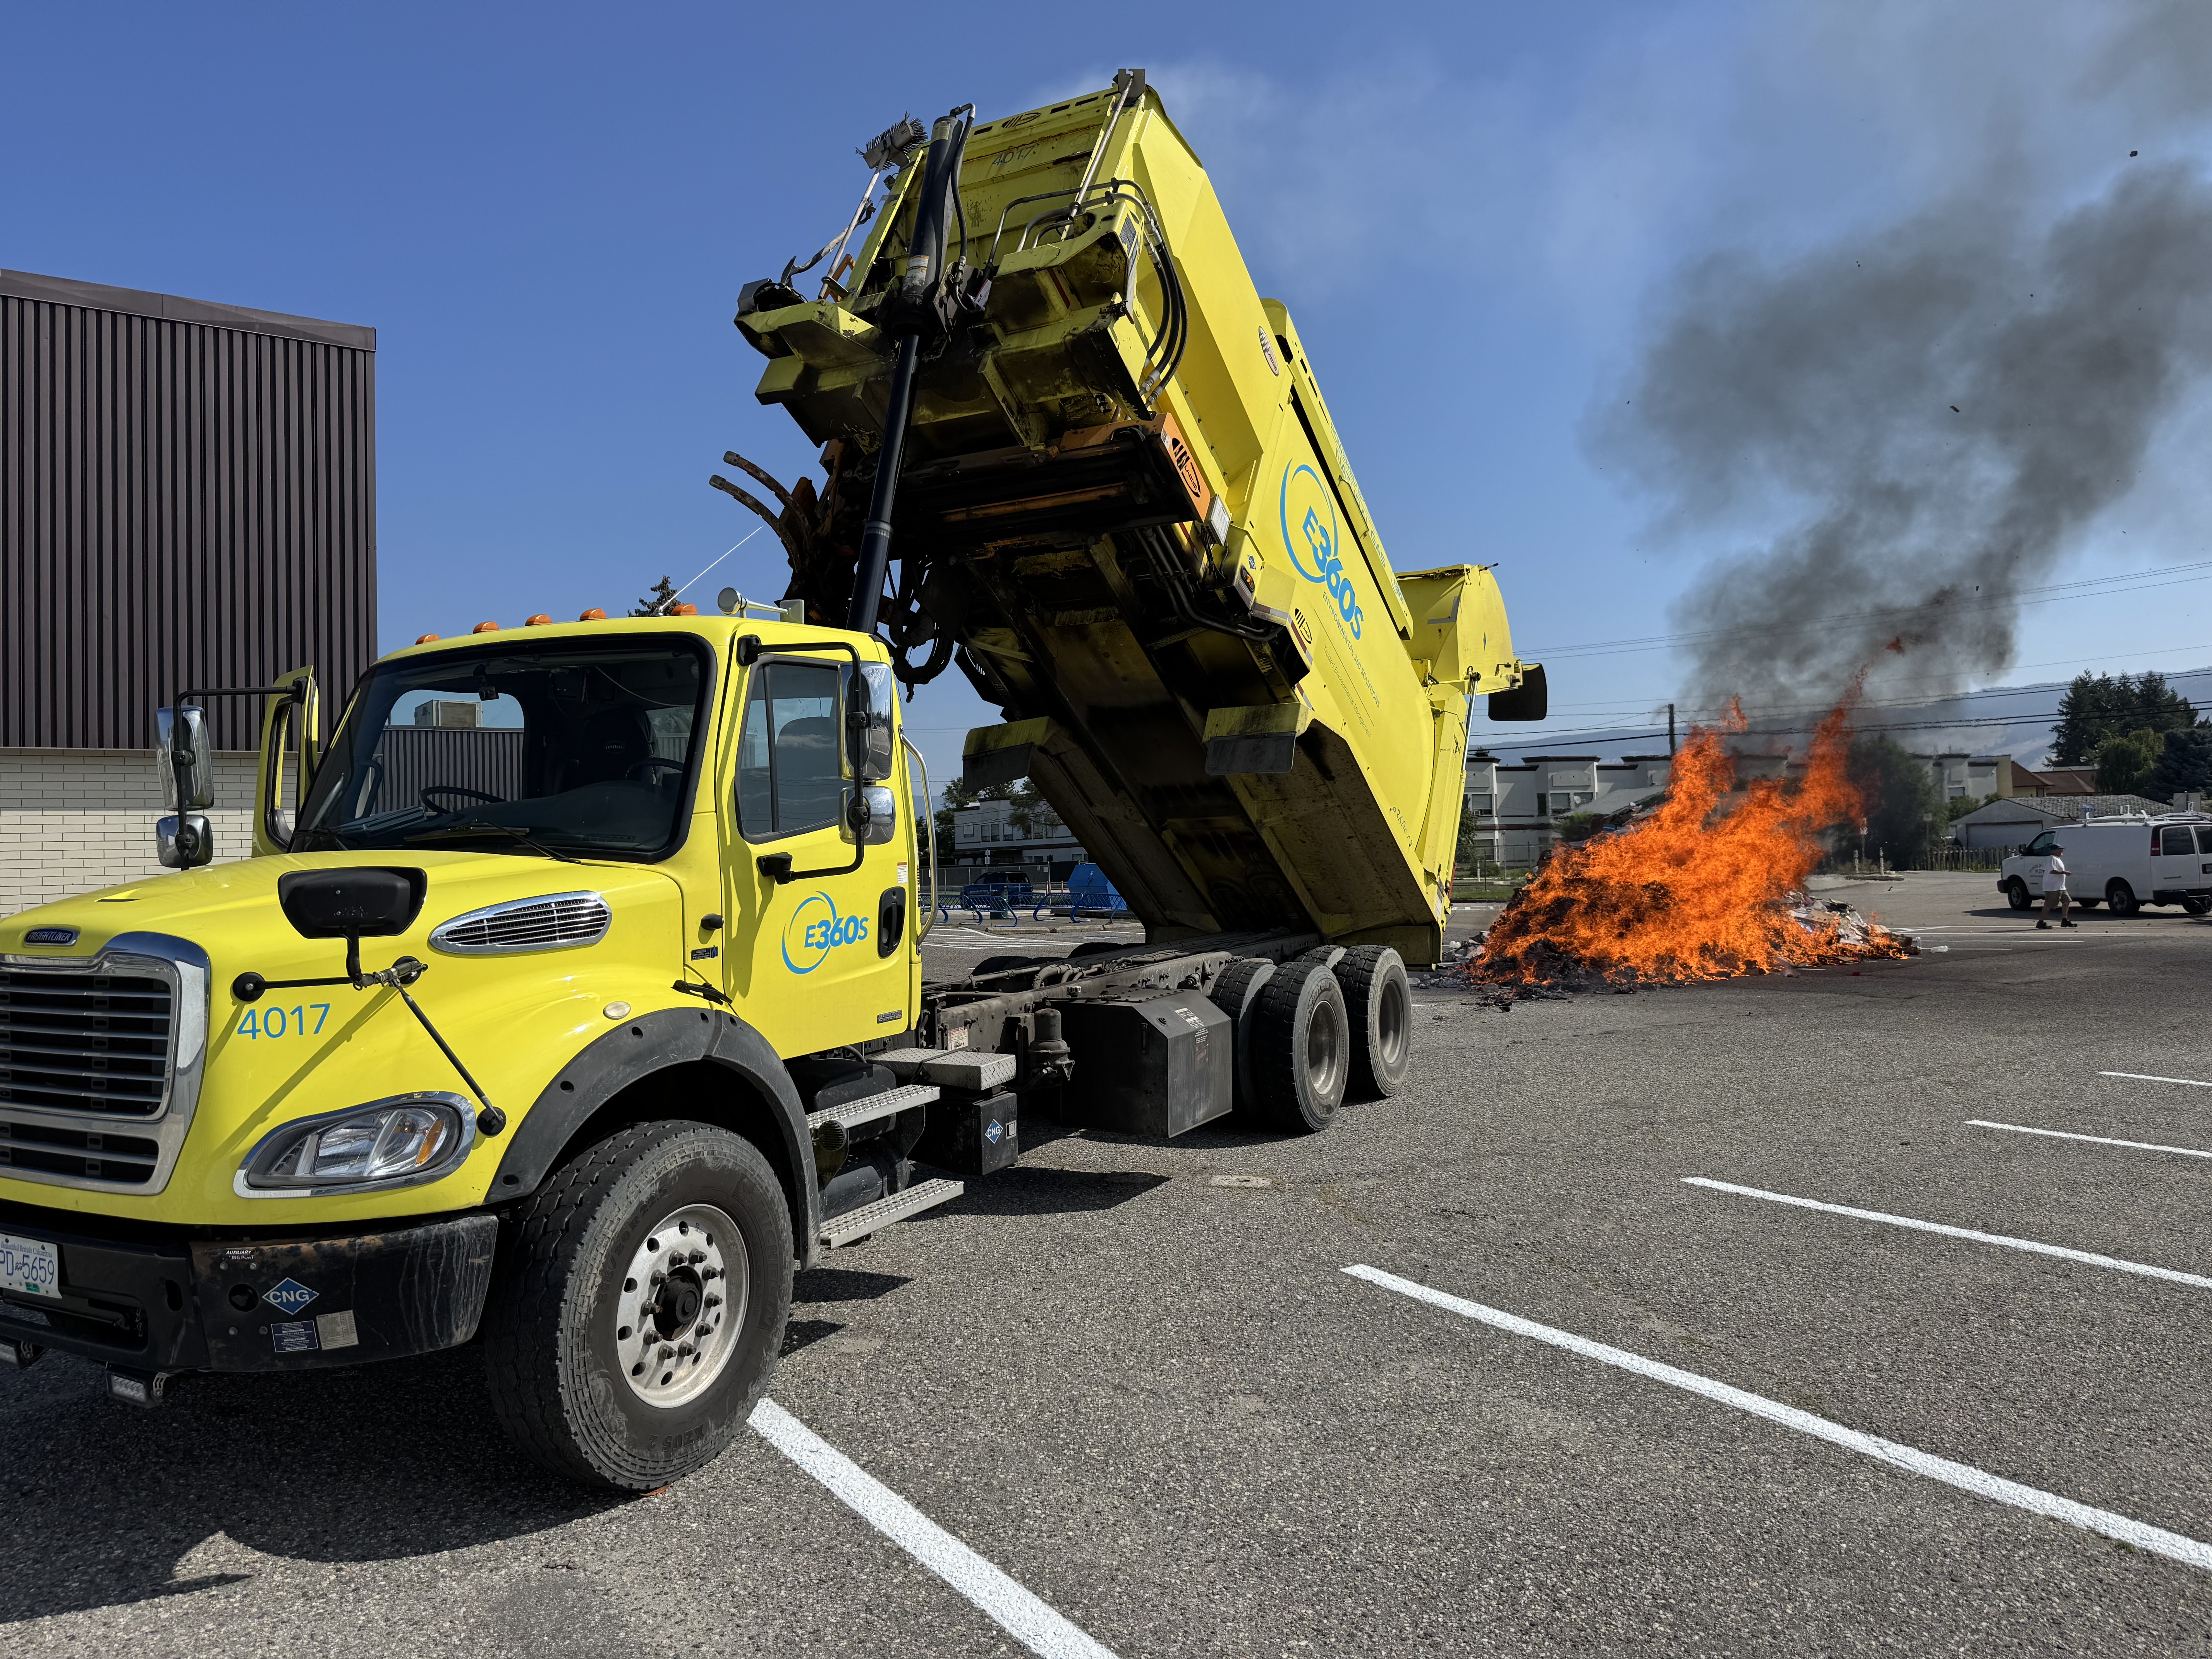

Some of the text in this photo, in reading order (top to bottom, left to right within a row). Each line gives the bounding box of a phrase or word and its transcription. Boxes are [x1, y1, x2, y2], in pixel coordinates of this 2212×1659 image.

[992, 145, 1036, 165] 4017
[1184, 465, 1198, 491] LABRIE
[1370, 530, 1385, 568] GAS
[1302, 505, 1364, 640] E360S
[1323, 591, 1354, 658] ENVIRONMENTAL
[1360, 668, 1380, 708] SOLUTIONS
[1323, 645, 1371, 738] Trusted Environmental Management
[27, 931, 72, 941] FREIGHTLINER
[804, 914, 869, 950] E360S
[237, 1003, 330, 1040] 4017
[987, 1125, 1000, 1137] CNG
[22, 1254, 55, 1285] 5659
[755, 1200, 778, 1328] MICHELIN
[268, 1288, 311, 1303] CNG
